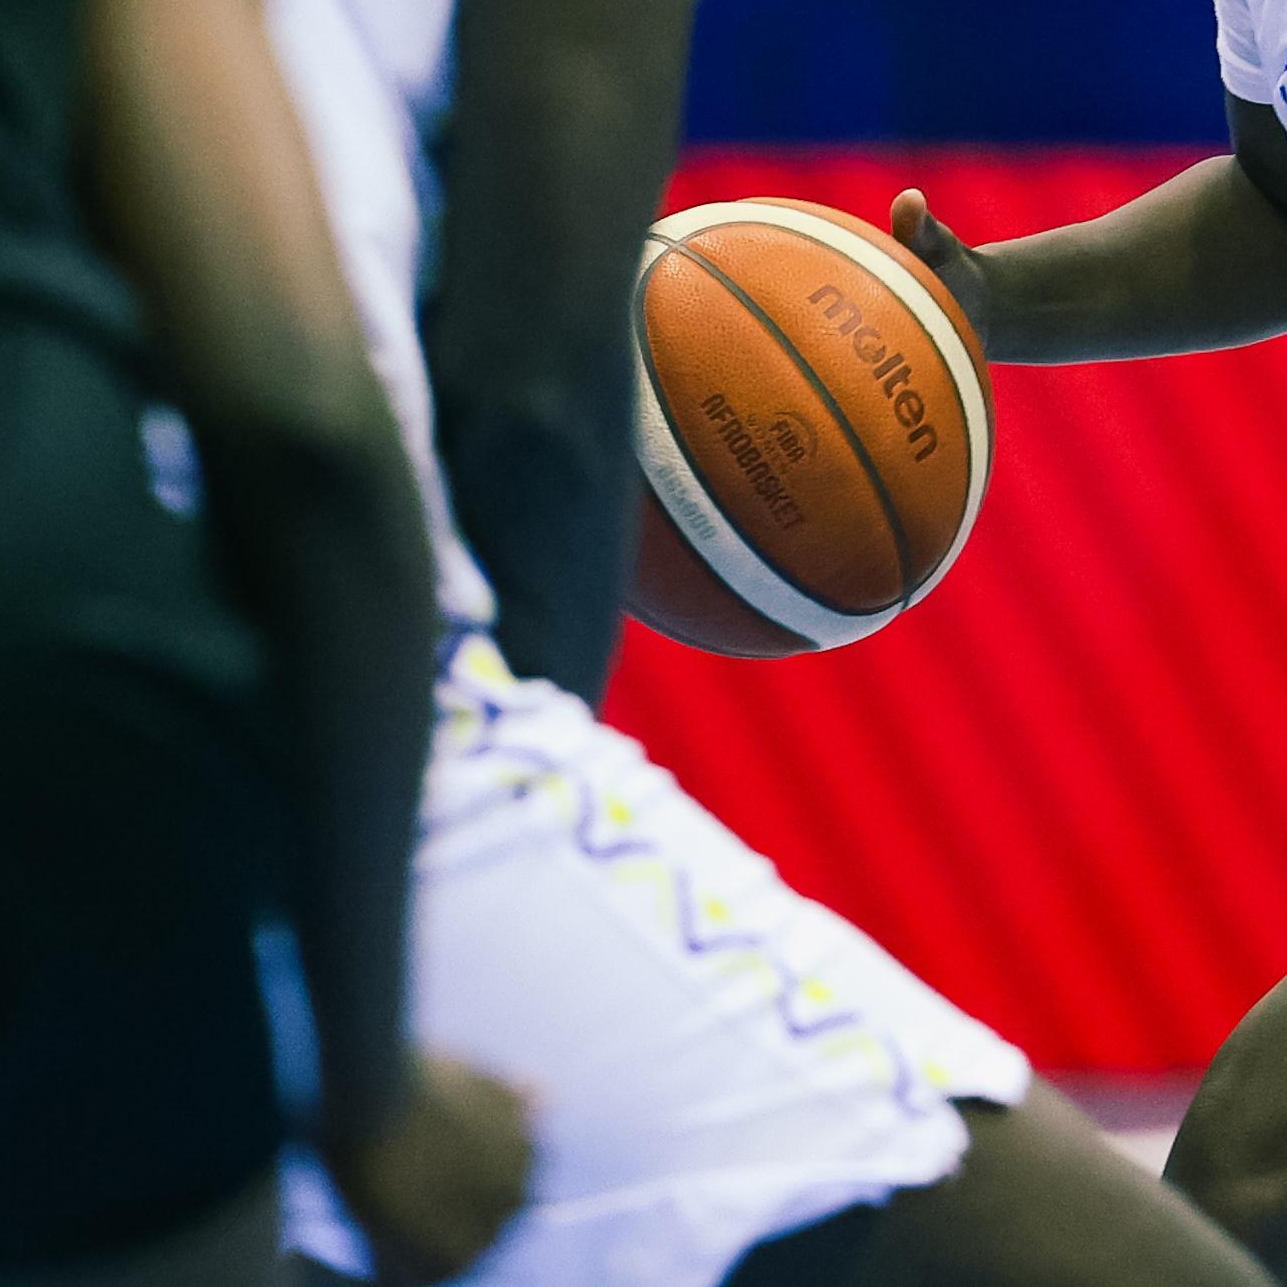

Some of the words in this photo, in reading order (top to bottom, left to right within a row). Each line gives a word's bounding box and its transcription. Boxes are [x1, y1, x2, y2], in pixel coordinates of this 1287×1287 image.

[769, 418, 806, 464] FIBA
[808, 283, 939, 464] molten
[700, 392, 804, 531] AFROBASKET
